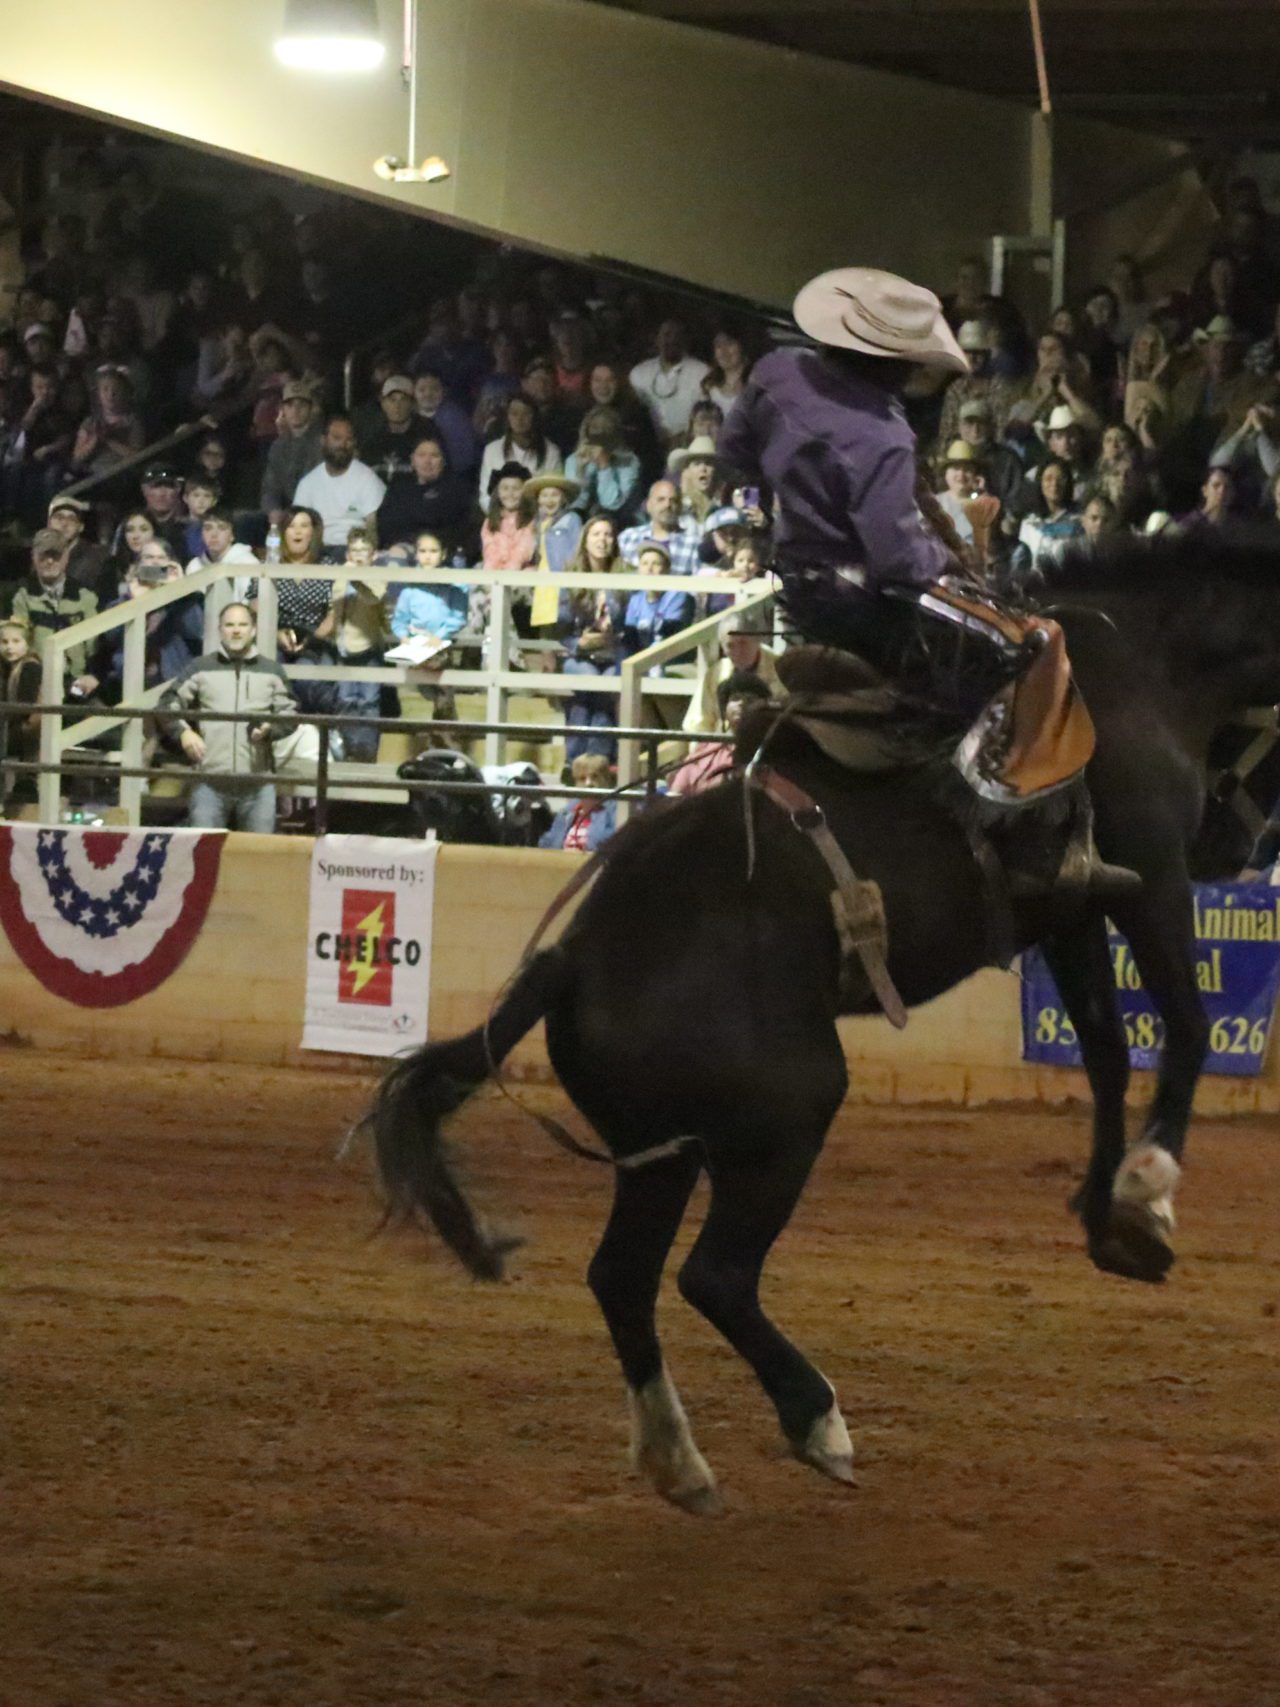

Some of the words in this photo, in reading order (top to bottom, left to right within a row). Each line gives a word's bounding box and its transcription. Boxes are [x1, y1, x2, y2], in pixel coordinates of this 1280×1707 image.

[317, 861, 396, 882] Sponsored
[399, 865, 425, 887] by:
[315, 931, 421, 967] CHELCO
